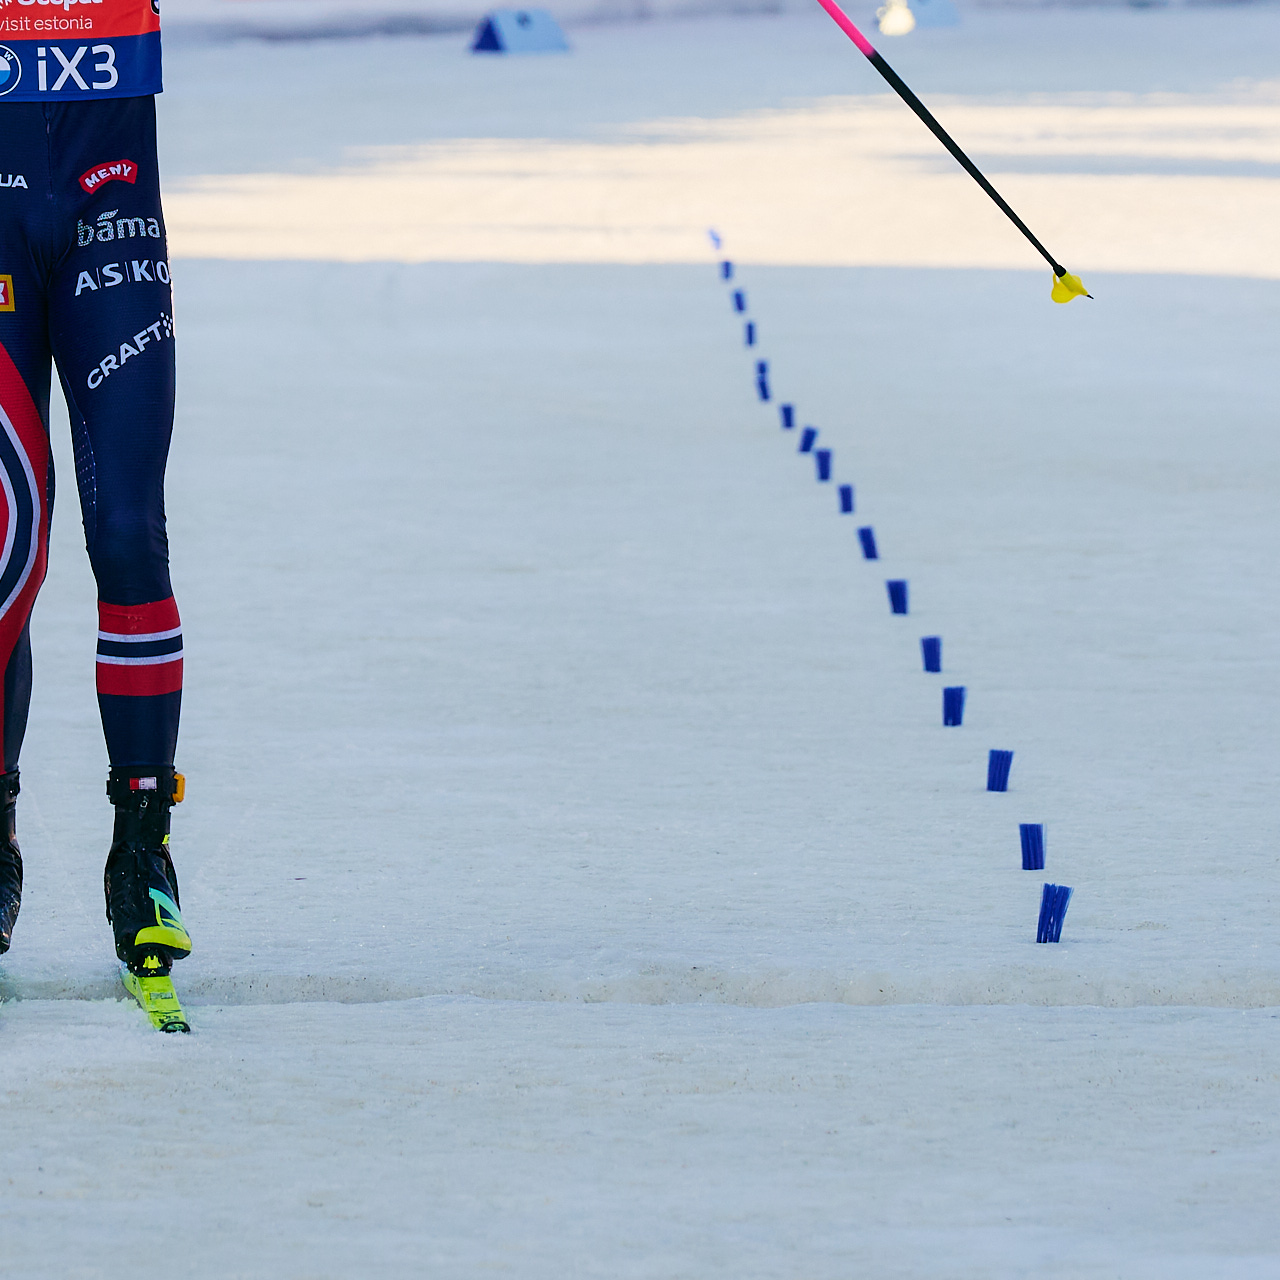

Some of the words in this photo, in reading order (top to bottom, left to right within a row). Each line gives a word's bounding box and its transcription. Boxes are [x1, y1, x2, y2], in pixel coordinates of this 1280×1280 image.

[33, 16, 93, 31] estonia
[36, 44, 119, 92] iX3
[84, 163, 132, 189] MENY
[86, 320, 163, 390] CRAFT
